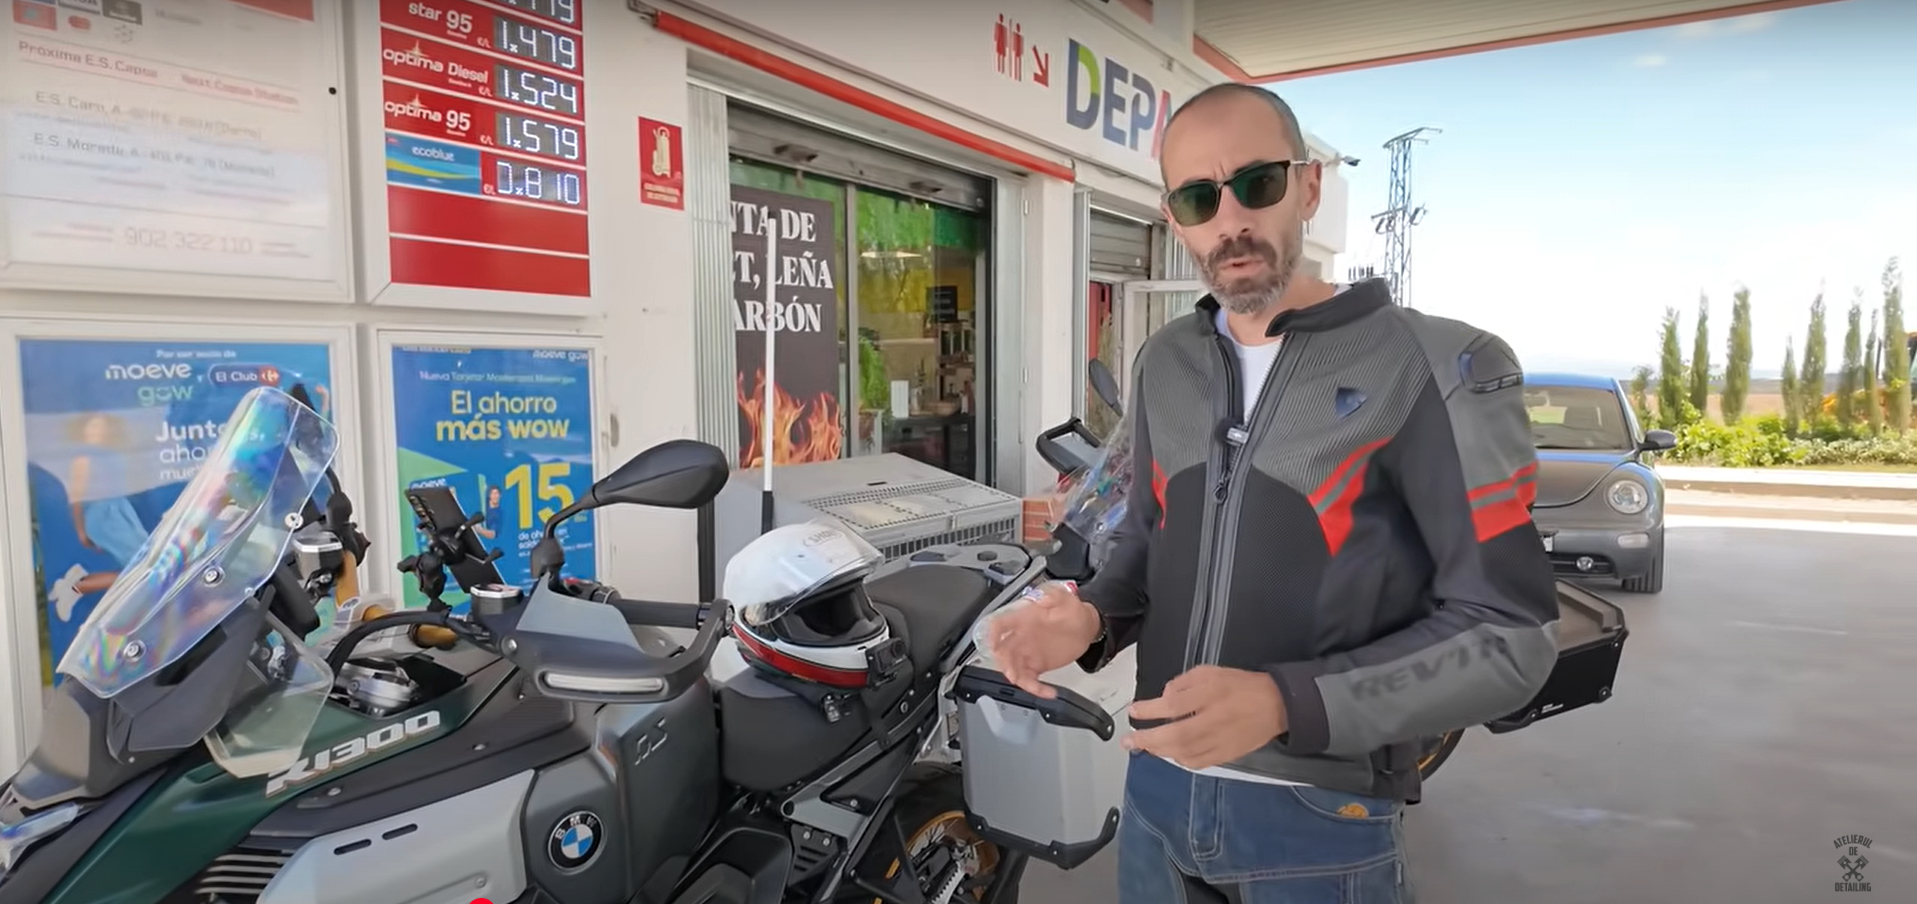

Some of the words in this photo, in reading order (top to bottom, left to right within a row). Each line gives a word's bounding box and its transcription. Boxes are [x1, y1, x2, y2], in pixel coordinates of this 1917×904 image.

[408, 3, 442, 21] star
[446, 9, 473, 34] 95
[382, 48, 444, 73] optima
[447, 61, 489, 84] Diesel
[384, 100, 442, 123] optima
[446, 110, 471, 132] 95
[411, 146, 455, 163] ecoblue
[780, 208, 818, 243] DE
[776, 250, 834, 289] EÑA
[105, 362, 193, 380] moeve
[215, 372, 228, 383] El
[230, 371, 258, 382] Club
[452, 390, 473, 415] El
[479, 391, 558, 415] ahorro
[436, 412, 502, 442] más
[507, 419, 570, 440] wow
[504, 461, 575, 531] 15
[266, 711, 440, 797] R1300
[555, 814, 598, 840] BMW
